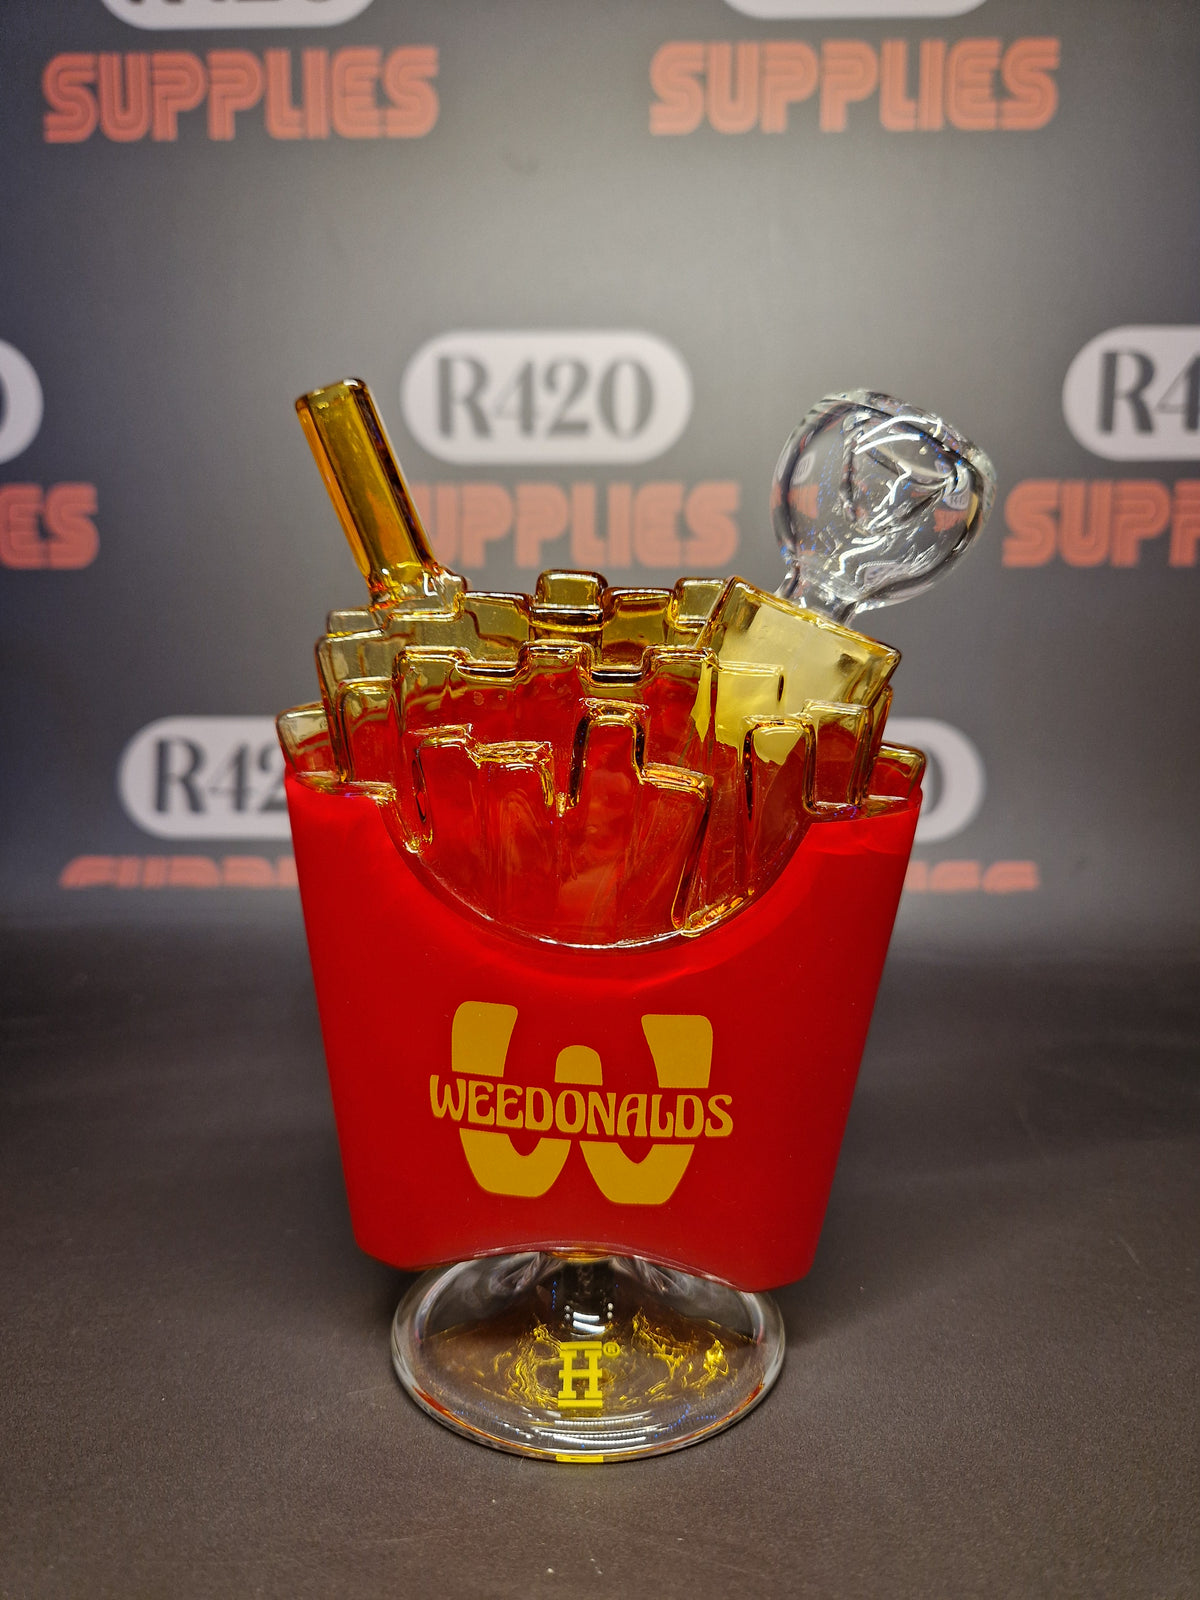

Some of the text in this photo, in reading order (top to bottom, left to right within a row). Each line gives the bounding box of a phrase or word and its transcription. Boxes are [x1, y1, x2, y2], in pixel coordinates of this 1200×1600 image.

[42, 46, 440, 143] SUPPLIES
[649, 37, 1061, 136] SUPPLIES
[435, 355, 654, 440] R420
[430, 1074, 734, 1138] WEEDONALDS
